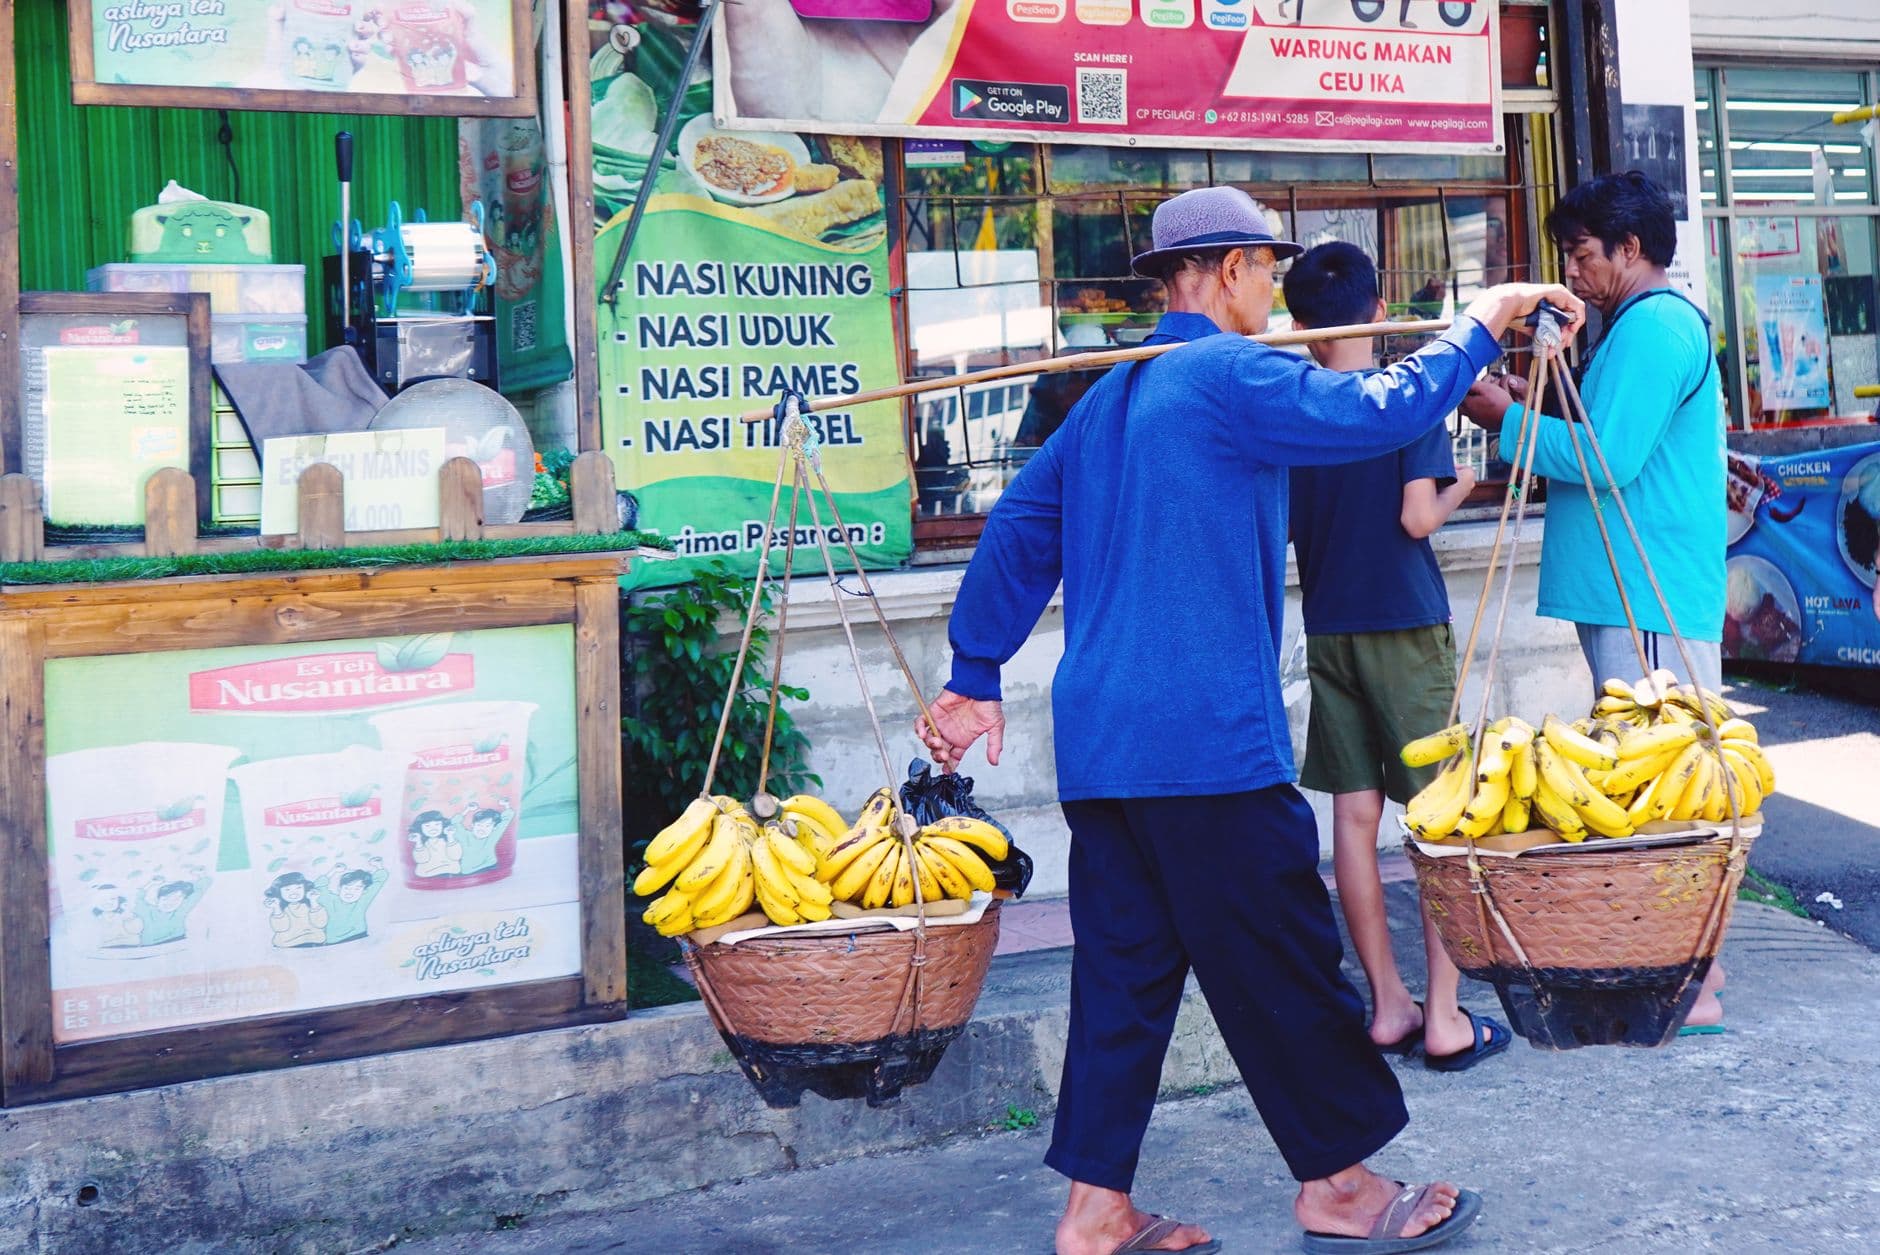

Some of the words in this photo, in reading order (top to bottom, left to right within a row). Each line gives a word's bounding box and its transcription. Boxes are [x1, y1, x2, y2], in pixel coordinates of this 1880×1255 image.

[1211, 13, 1246, 25] PegiFood
[108, 22, 227, 52] Nusantara
[1074, 52, 1100, 62] SCAN
[1102, 54, 1127, 64] HERE
[1270, 38, 1367, 60] WARUNG
[1373, 44, 1452, 64] MAKAN
[987, 87, 1000, 95] GET
[1010, 89, 1023, 97] ON
[1319, 71, 1363, 92] CEU
[1370, 74, 1405, 94] IKA
[988, 97, 1034, 117] Google
[1036, 101, 1062, 119] Play
[1136, 109, 1150, 119] CP
[1152, 109, 1195, 121] PEGILAGI
[1220, 112, 1238, 122] +62
[1240, 112, 1309, 124] 815-1941-5285
[1334, 114, 1402, 128] cs@pegilagi.com
[1407, 118, 1488, 130] www.pegilagi.com
[637, 263, 726, 296] NASI
[734, 264, 873, 296] KUNING
[639, 315, 728, 348] NASI
[739, 314, 834, 346] UDUK
[641, 366, 729, 400] NASI
[743, 364, 860, 396] RAMES
[645, 418, 730, 452] NASI
[740, 414, 862, 447] TIBEL
[363, 449, 430, 480] MANIS
[1778, 461, 1831, 476] CHICKEN
[746, 523, 864, 549] Pesanan
[1805, 596, 1829, 608] HOT
[1832, 597, 1861, 609] LAVA
[296, 663, 324, 676] Es
[328, 658, 375, 675] Teh
[216, 671, 452, 705] Nusantara
[275, 805, 373, 826] Nusantara
[85, 817, 195, 838] Nusantara
[414, 932, 490, 957] aslinya
[495, 917, 529, 941] teh
[416, 946, 530, 981] Nusantara
[63, 999, 89, 1013] Es
[97, 992, 138, 1009] Teh
[63, 1014, 89, 1030] Es
[98, 1008, 138, 1026] Teh
